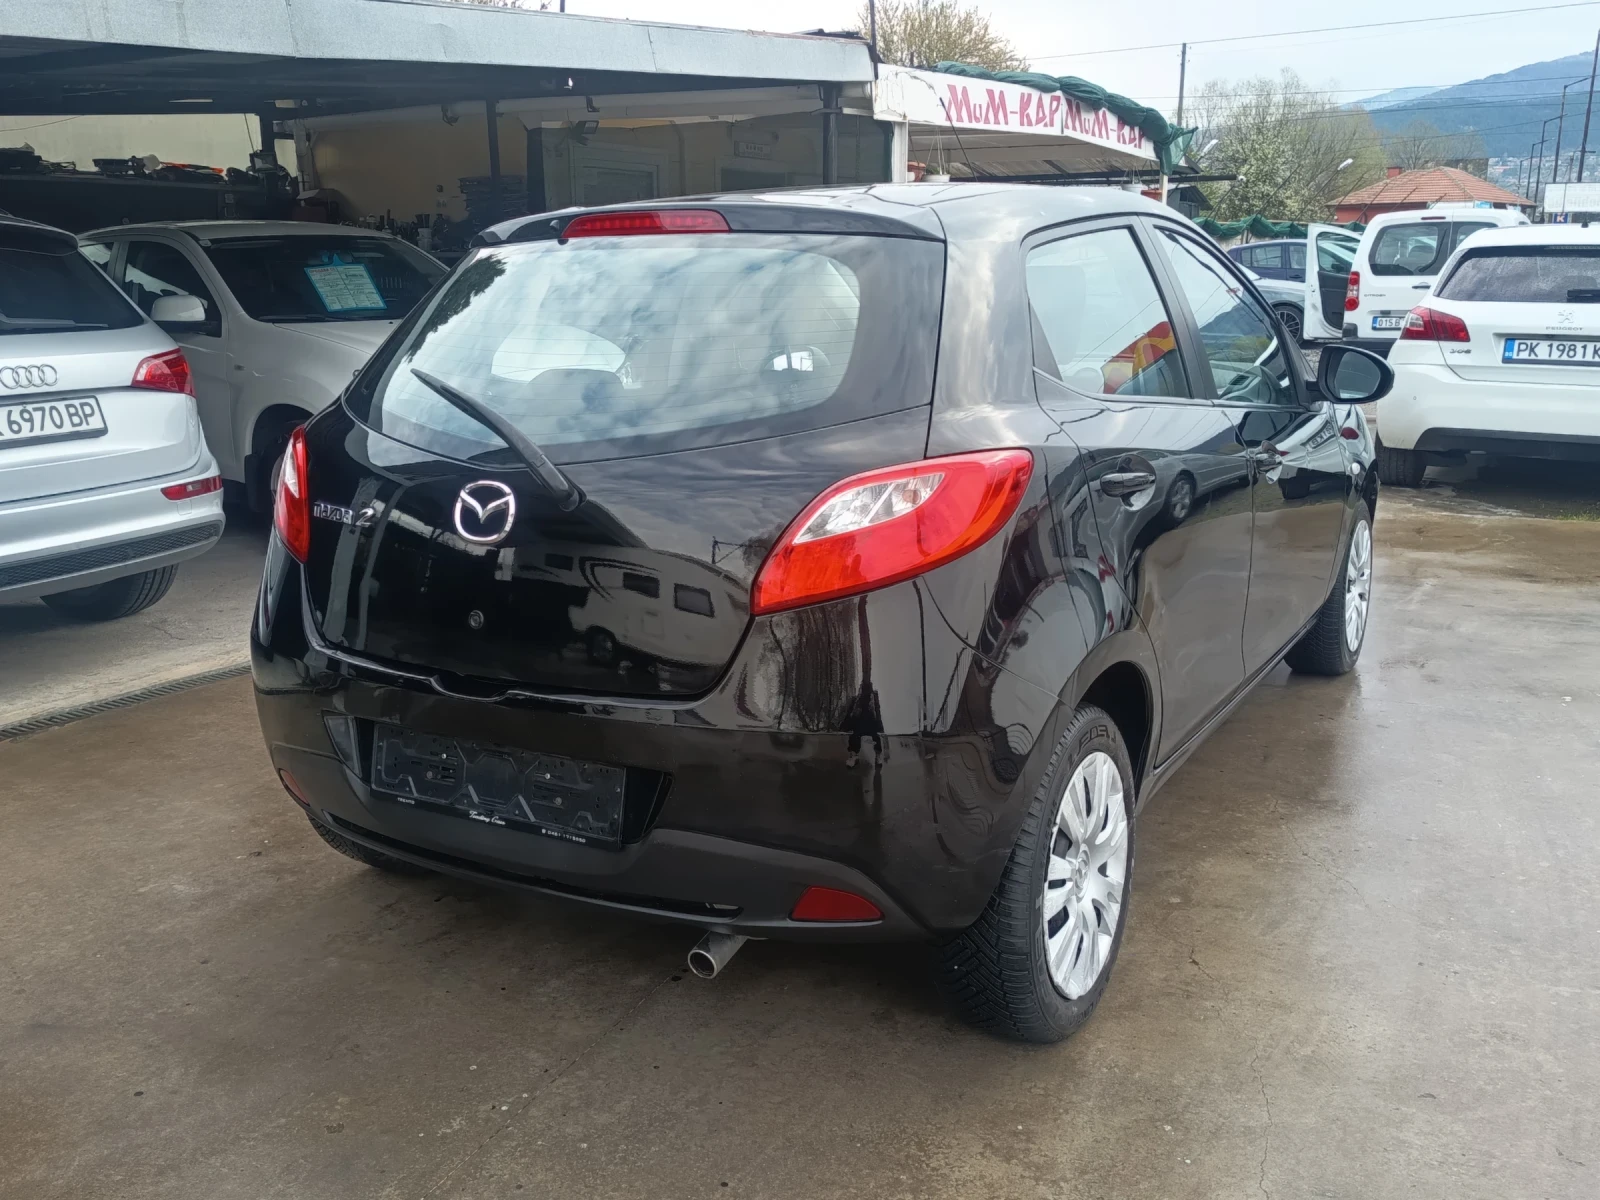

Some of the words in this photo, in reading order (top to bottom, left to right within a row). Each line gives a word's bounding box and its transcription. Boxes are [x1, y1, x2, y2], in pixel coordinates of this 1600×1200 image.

[1378, 318, 1393, 327] 015
[1516, 341, 1540, 358] PK
[1547, 342, 1587, 359] 1981
[7, 405, 64, 434] 6970
[64, 402, 95, 427] BP
